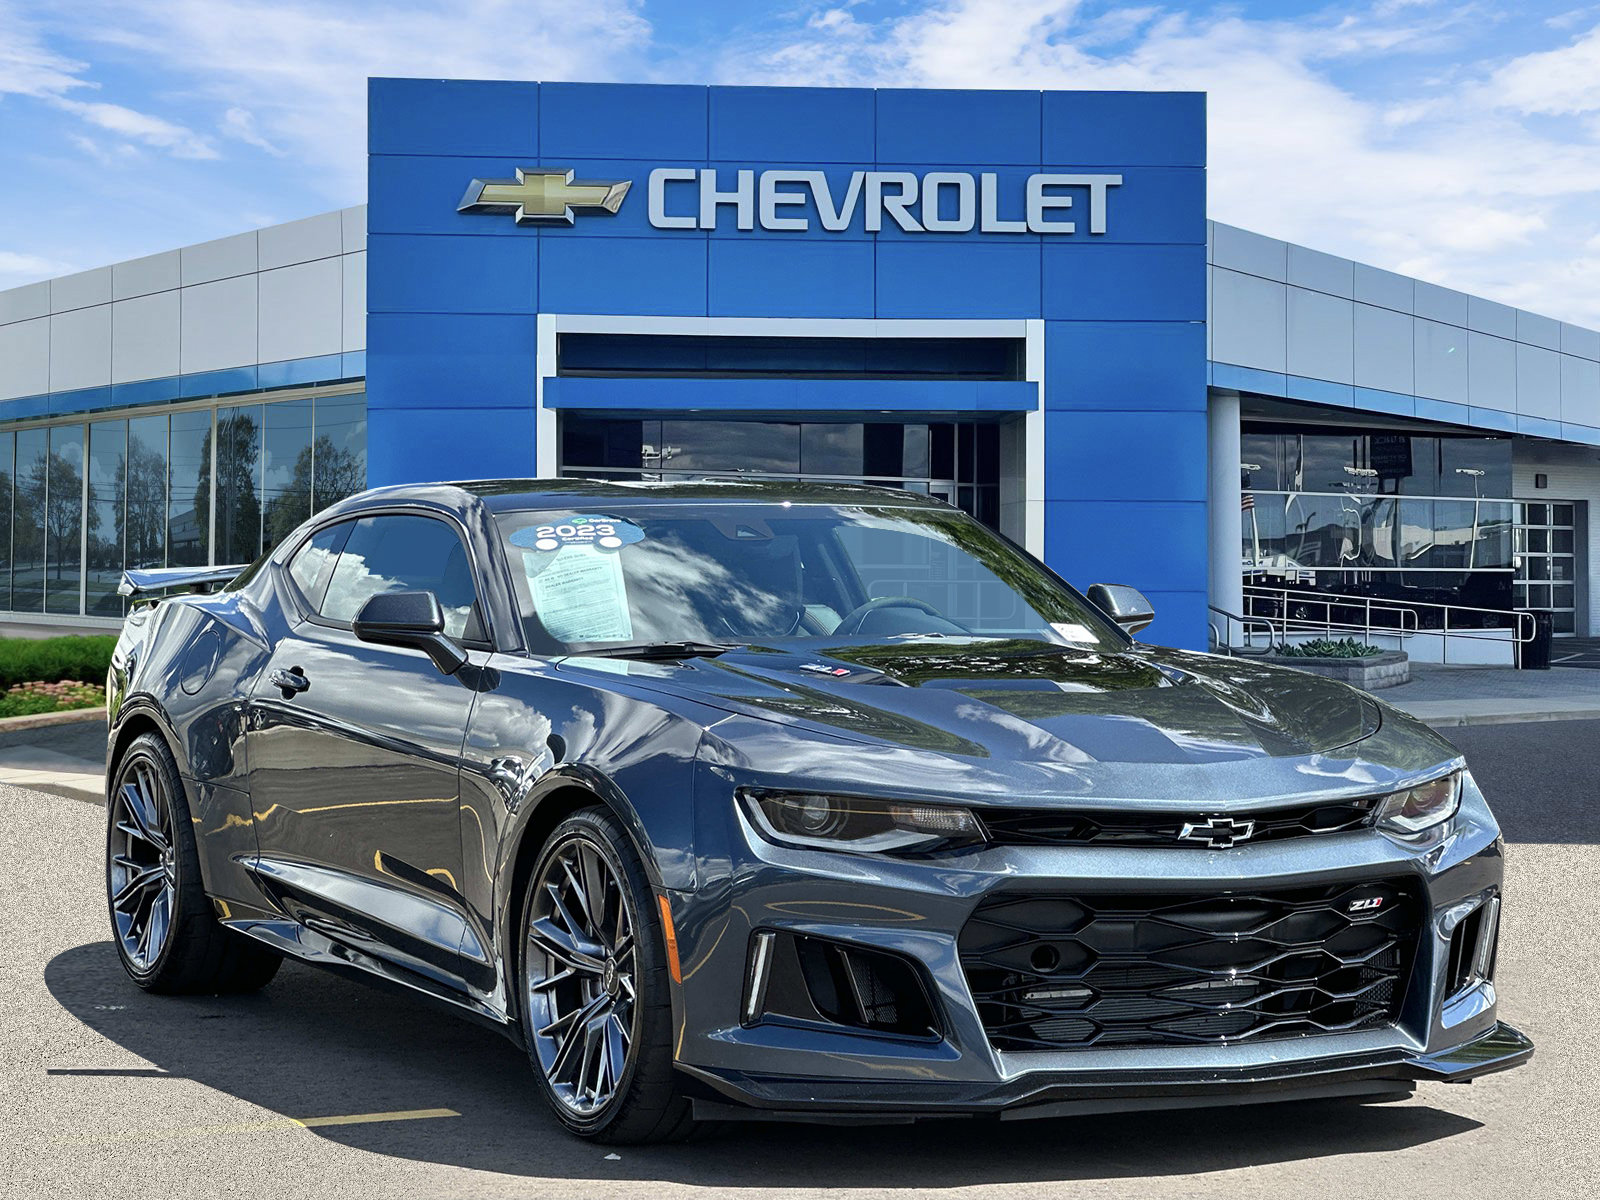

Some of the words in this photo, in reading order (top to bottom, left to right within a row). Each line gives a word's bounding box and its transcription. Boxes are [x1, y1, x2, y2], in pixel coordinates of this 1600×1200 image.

[648, 168, 1123, 234] CHEVROLET
[536, 524, 616, 539] 2023
[1349, 897, 1383, 912] ZL1
